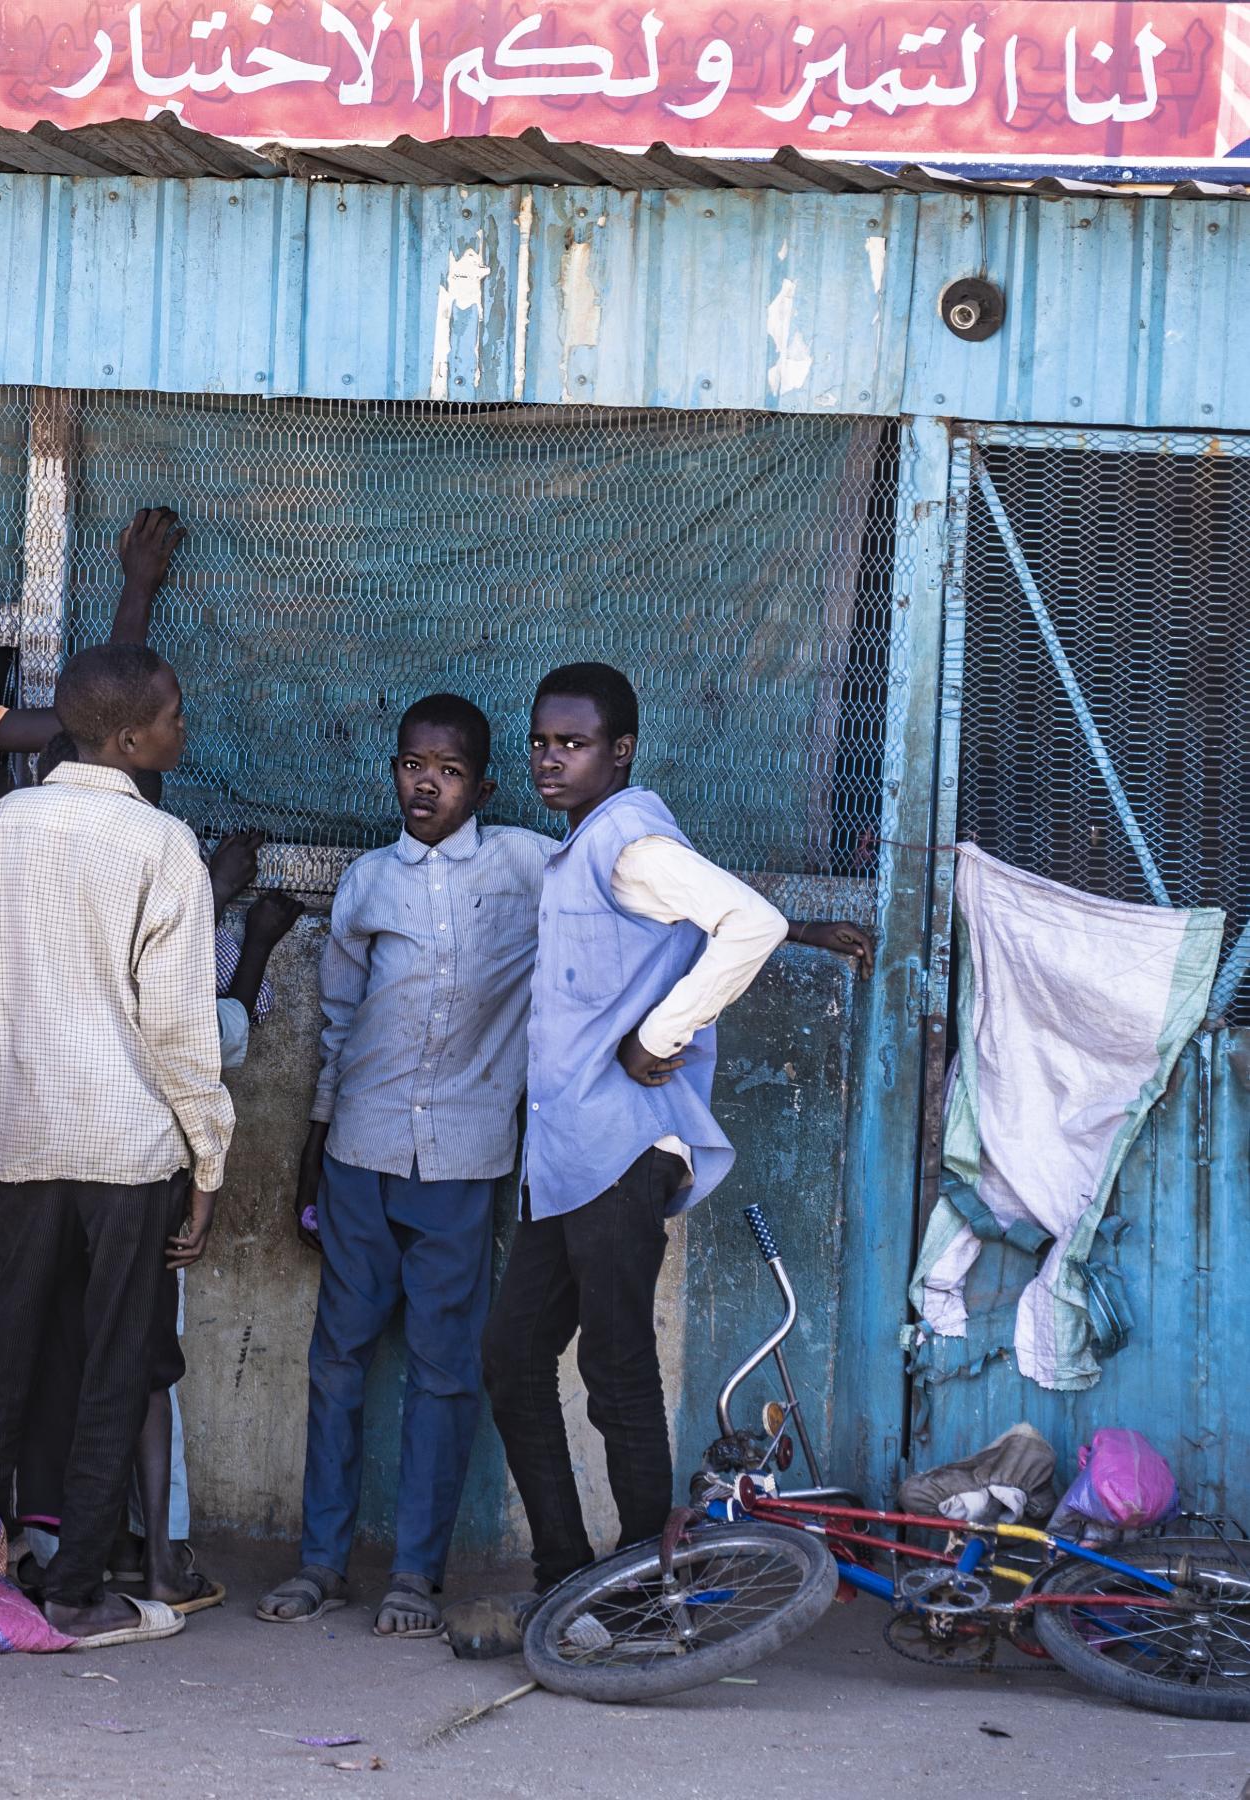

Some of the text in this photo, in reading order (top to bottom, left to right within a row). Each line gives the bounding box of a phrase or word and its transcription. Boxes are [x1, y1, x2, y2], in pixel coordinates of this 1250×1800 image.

[48, 1, 423, 123] الاختيار
[751, 23, 1018, 133] التميز
[1064, 21, 1167, 126] لنا
